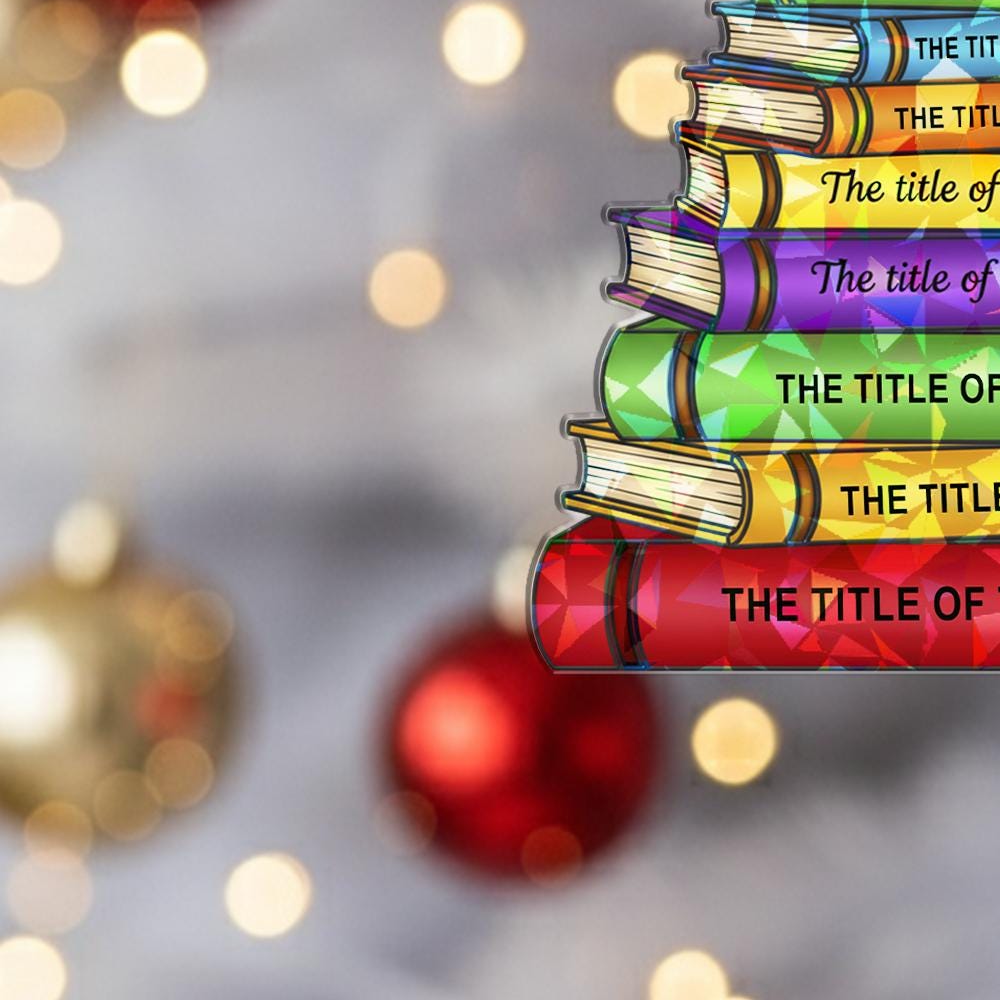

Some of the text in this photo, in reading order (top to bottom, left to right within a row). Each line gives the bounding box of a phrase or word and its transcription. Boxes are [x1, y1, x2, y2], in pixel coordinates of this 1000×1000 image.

[915, 37, 958, 59] THE
[895, 107, 943, 129] THE
[821, 169, 884, 203] The
[896, 170, 958, 202] title
[811, 259, 875, 293] The
[886, 260, 948, 293] title
[961, 260, 993, 303] of
[776, 374, 842, 404] THE
[854, 374, 948, 403] TITLE
[841, 485, 907, 515] THE
[722, 587, 797, 621] THE
[812, 587, 919, 621] TITLE
[934, 587, 983, 620] OF
